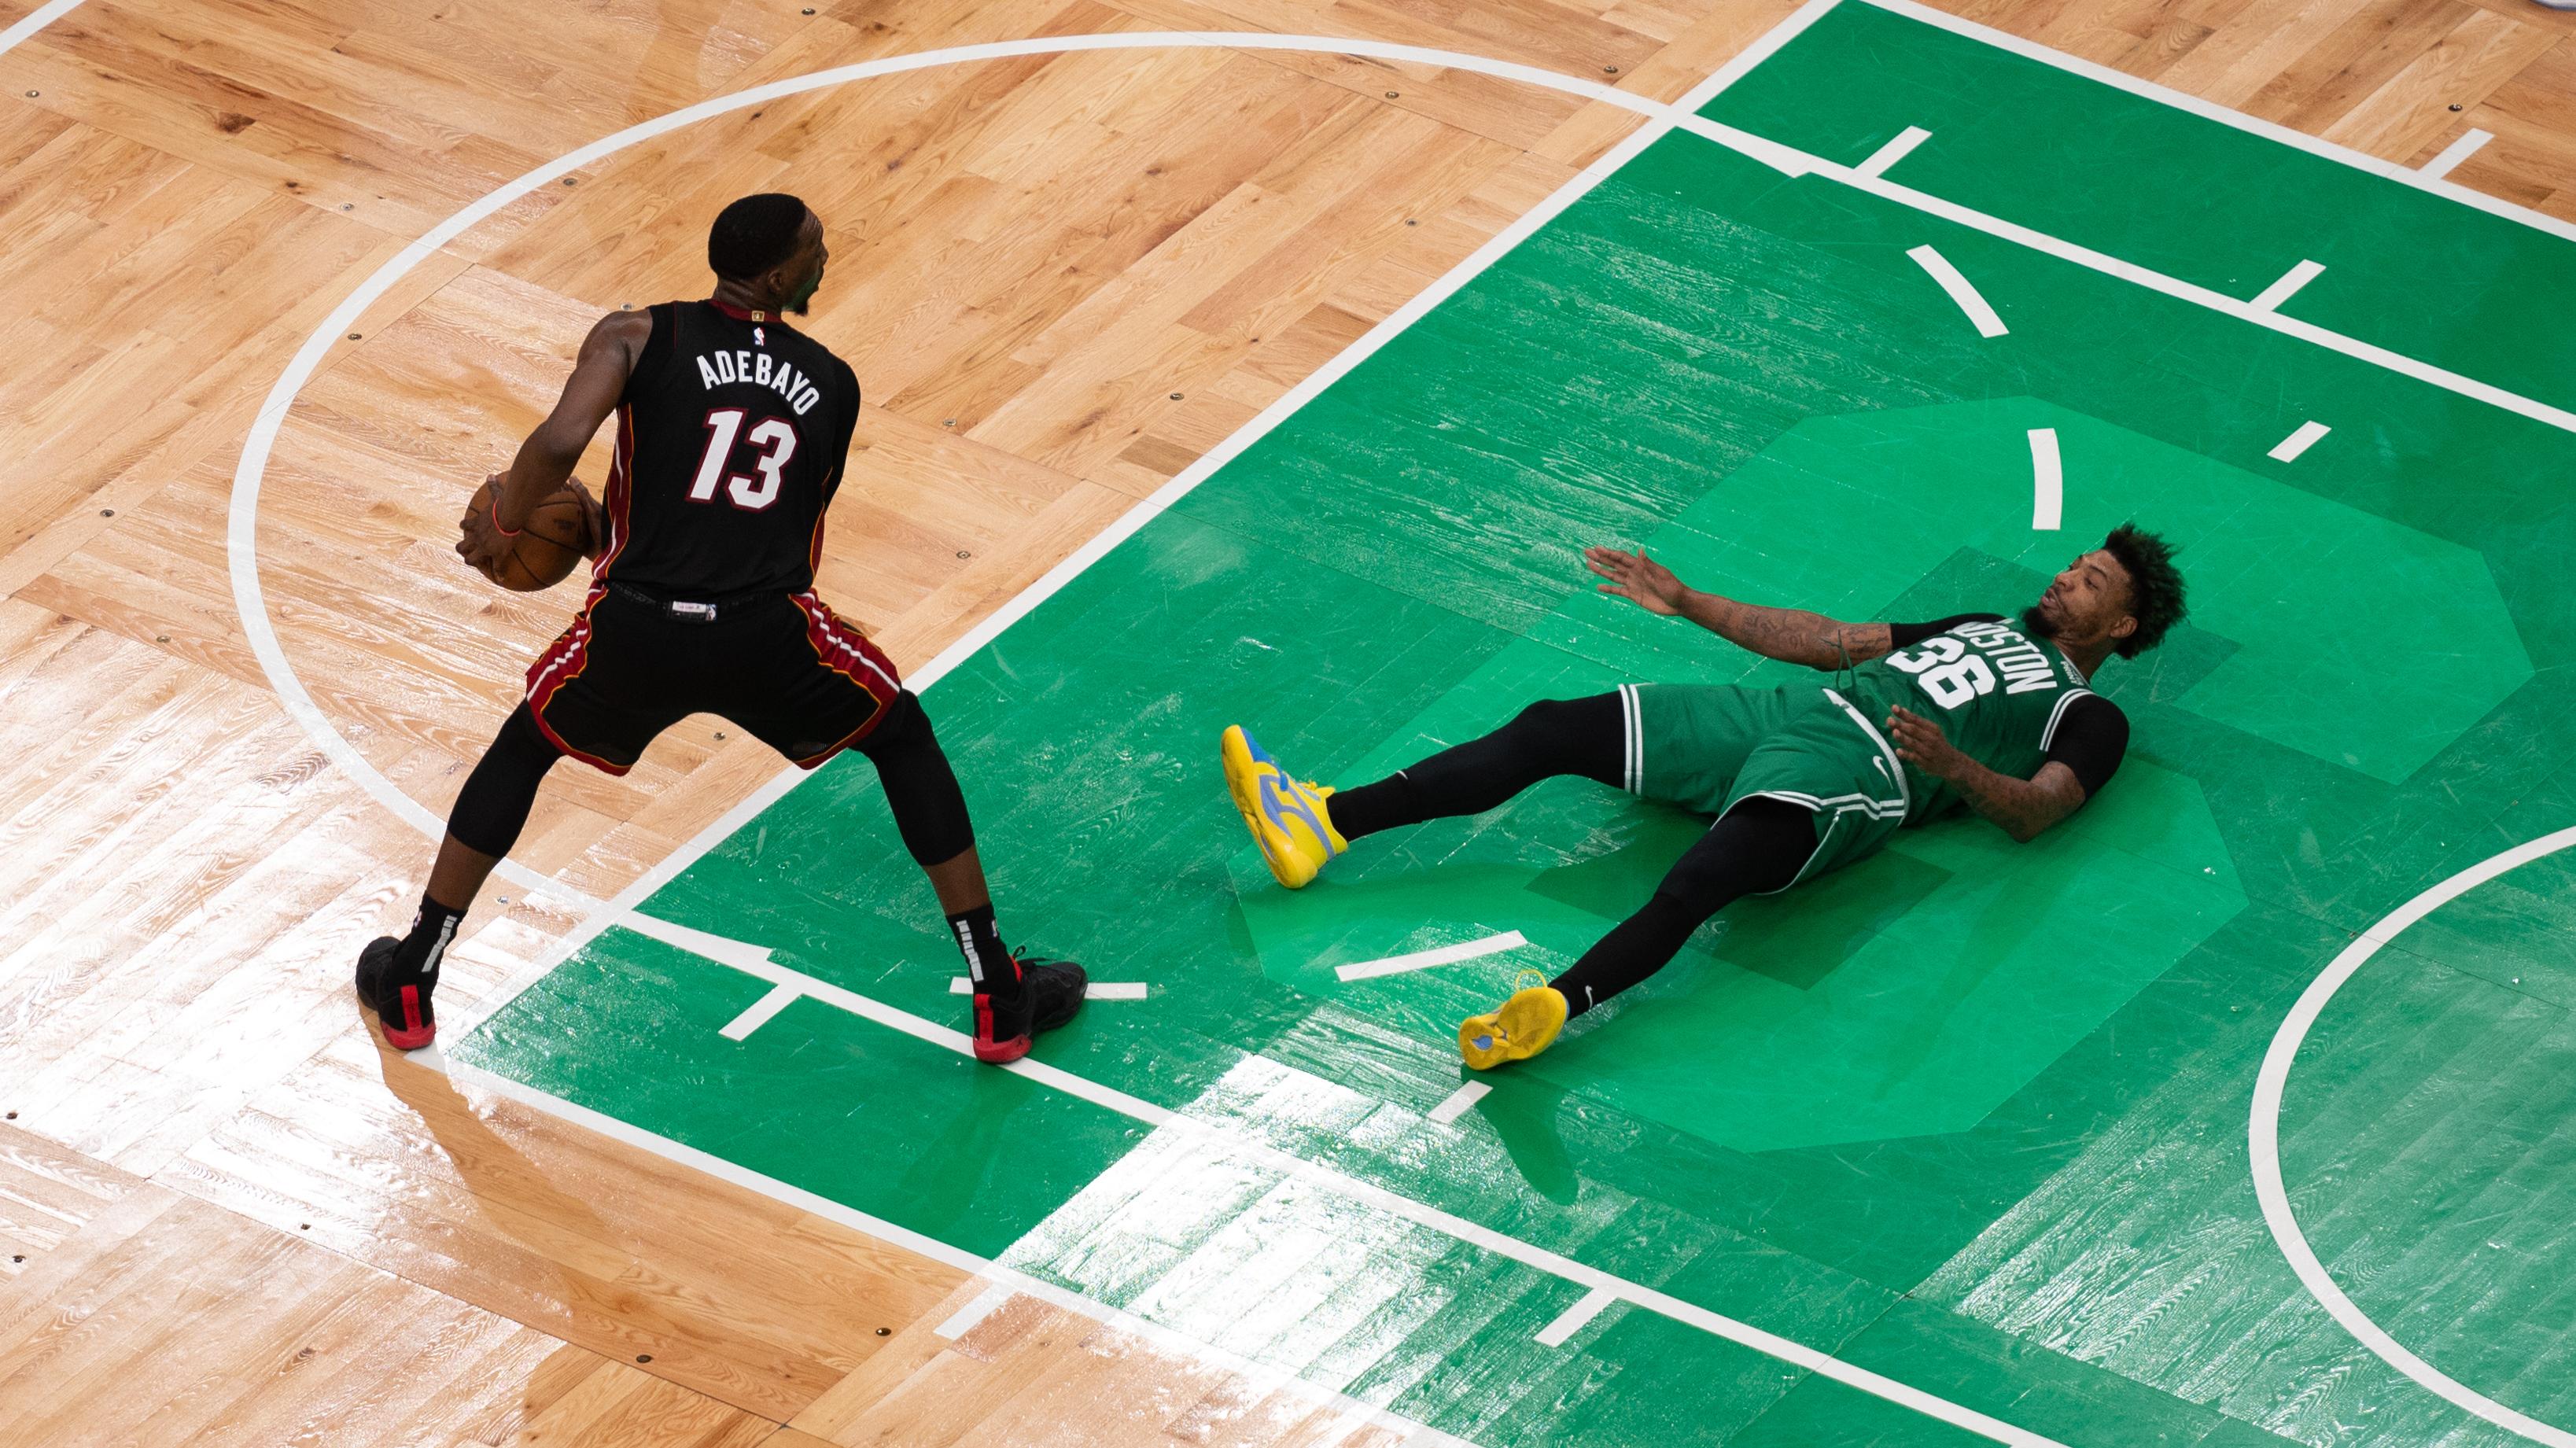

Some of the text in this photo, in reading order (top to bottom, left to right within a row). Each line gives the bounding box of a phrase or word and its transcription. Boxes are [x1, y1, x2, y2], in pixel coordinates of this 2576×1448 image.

[697, 350, 820, 415] ADEBAYO
[686, 407, 800, 513] 13
[1885, 636, 1996, 710] 36
